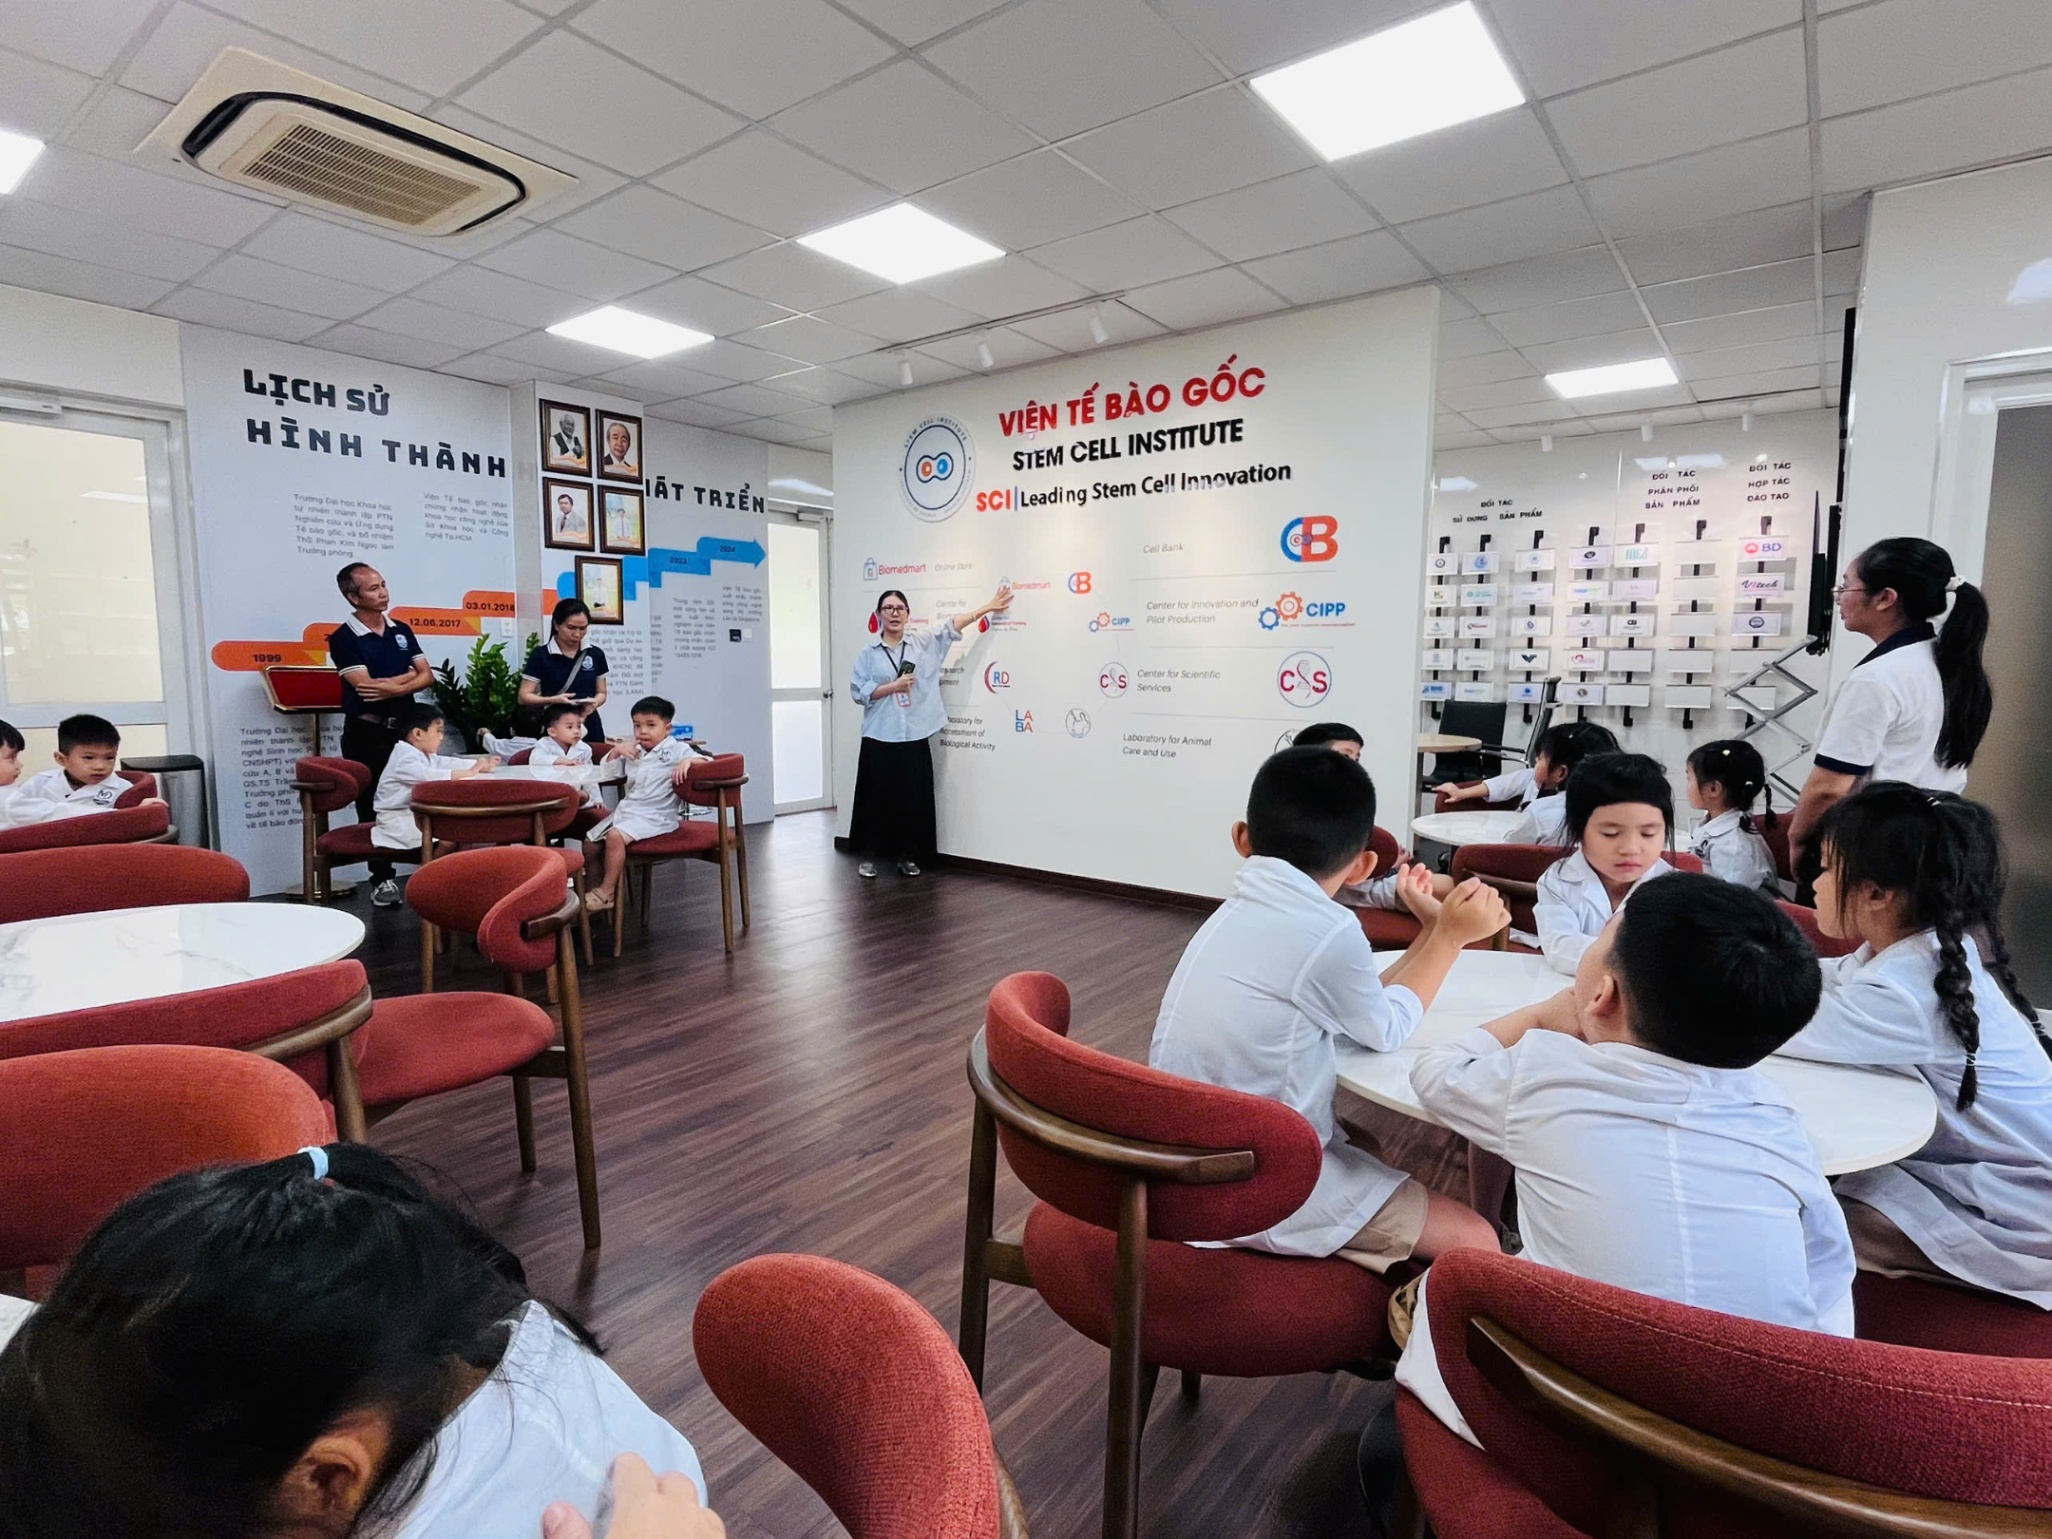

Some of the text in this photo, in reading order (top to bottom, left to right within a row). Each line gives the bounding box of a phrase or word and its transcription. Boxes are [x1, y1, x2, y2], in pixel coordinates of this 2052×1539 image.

[243, 368, 390, 416] LỊCH SỬ
[999, 353, 1266, 440] VIỆN TẾ BÀO GỐC
[247, 416, 506, 478] HÌNH THÀNH
[1013, 418, 1243, 470] STEM CELL INSTITUTE
[976, 489, 1011, 512] SCI
[1020, 485, 1087, 507] Leading
[1092, 480, 1136, 500] Stem
[1141, 473, 1175, 495] Cell
[1181, 463, 1292, 491] Innovation
[694, 483, 764, 513] TRIỂN
[1143, 543, 1184, 554] Cell Bank
[1762, 543, 1781, 552] BD
[878, 563, 926, 575] Biomedmart
[466, 603, 514, 611] 03.01.2018
[1146, 599, 1258, 610] Center for Innovation and
[1306, 602, 1346, 617] CIPP
[1112, 617, 1130, 626] CIPP
[1146, 614, 1216, 624] Pilot Production
[253, 654, 281, 662] 1999
[1138, 670, 1220, 679] Center for Scientific
[1137, 684, 1171, 692] Services
[948, 717, 972, 725] boratory
[940, 739, 996, 751] Biological Activity
[1123, 734, 1212, 746] Laboratory for Animal
[1122, 747, 1176, 758] Care and Use
